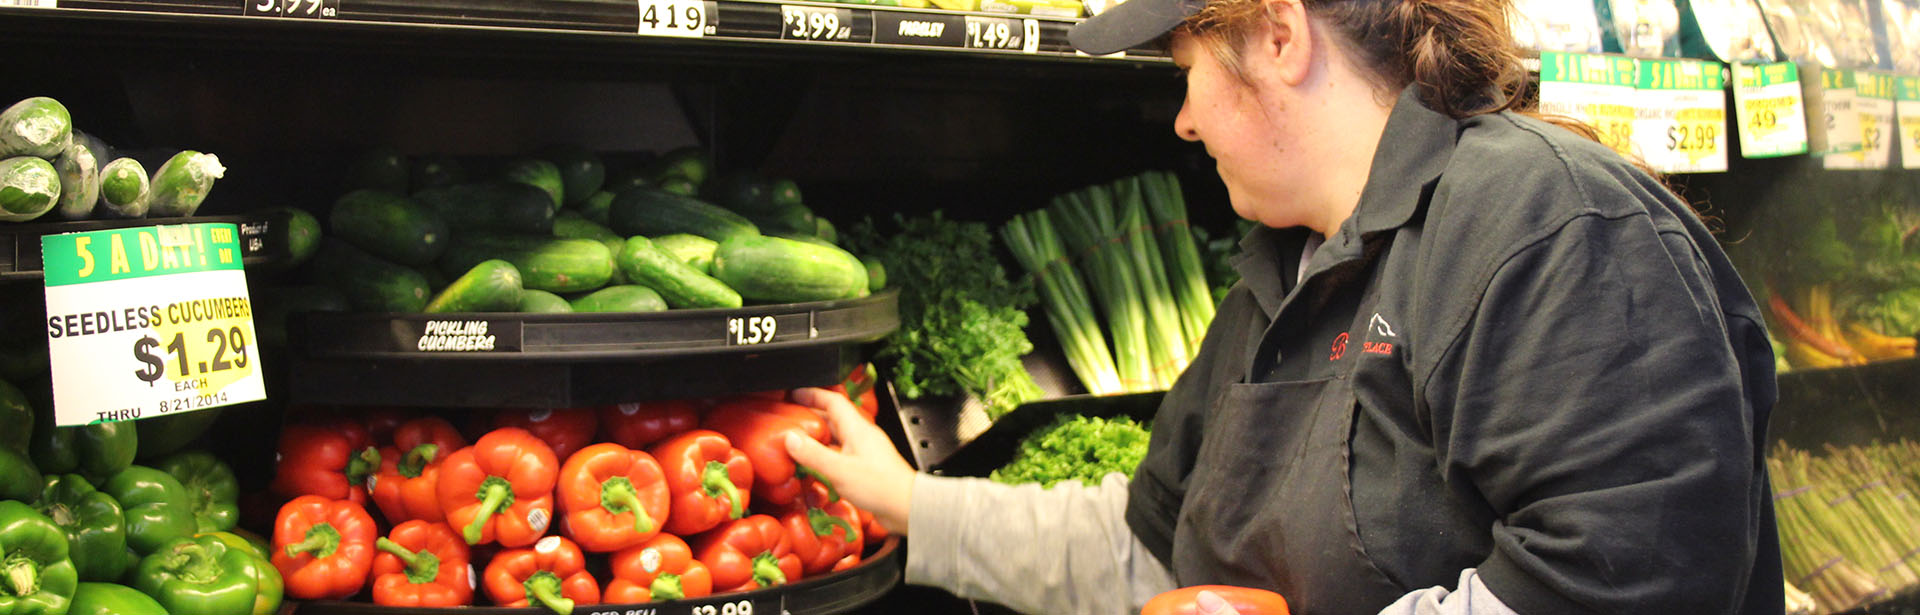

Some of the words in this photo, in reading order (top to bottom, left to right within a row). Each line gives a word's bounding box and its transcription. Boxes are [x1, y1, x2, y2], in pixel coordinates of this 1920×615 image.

[322, 7, 336, 17] ea
[784, 10, 839, 39] $3.99
[898, 20, 945, 38] PARSLEY
[967, 22, 1010, 48] $1.49
[1667, 125, 1716, 151] $2.99
[75, 236, 95, 278] 5
[111, 233, 131, 274] A
[138, 227, 207, 271] DAY!
[49, 305, 162, 339] SEEDLESS
[168, 297, 250, 325] CUCUMBERS
[425, 320, 488, 335] PICKLING
[729, 316, 777, 345] $1.59
[133, 325, 248, 387] $1.29
[418, 335, 496, 351] CUCMBERS
[174, 378, 209, 392] EACH
[97, 407, 142, 423] THRU
[159, 391, 229, 413] 8/21/2014
